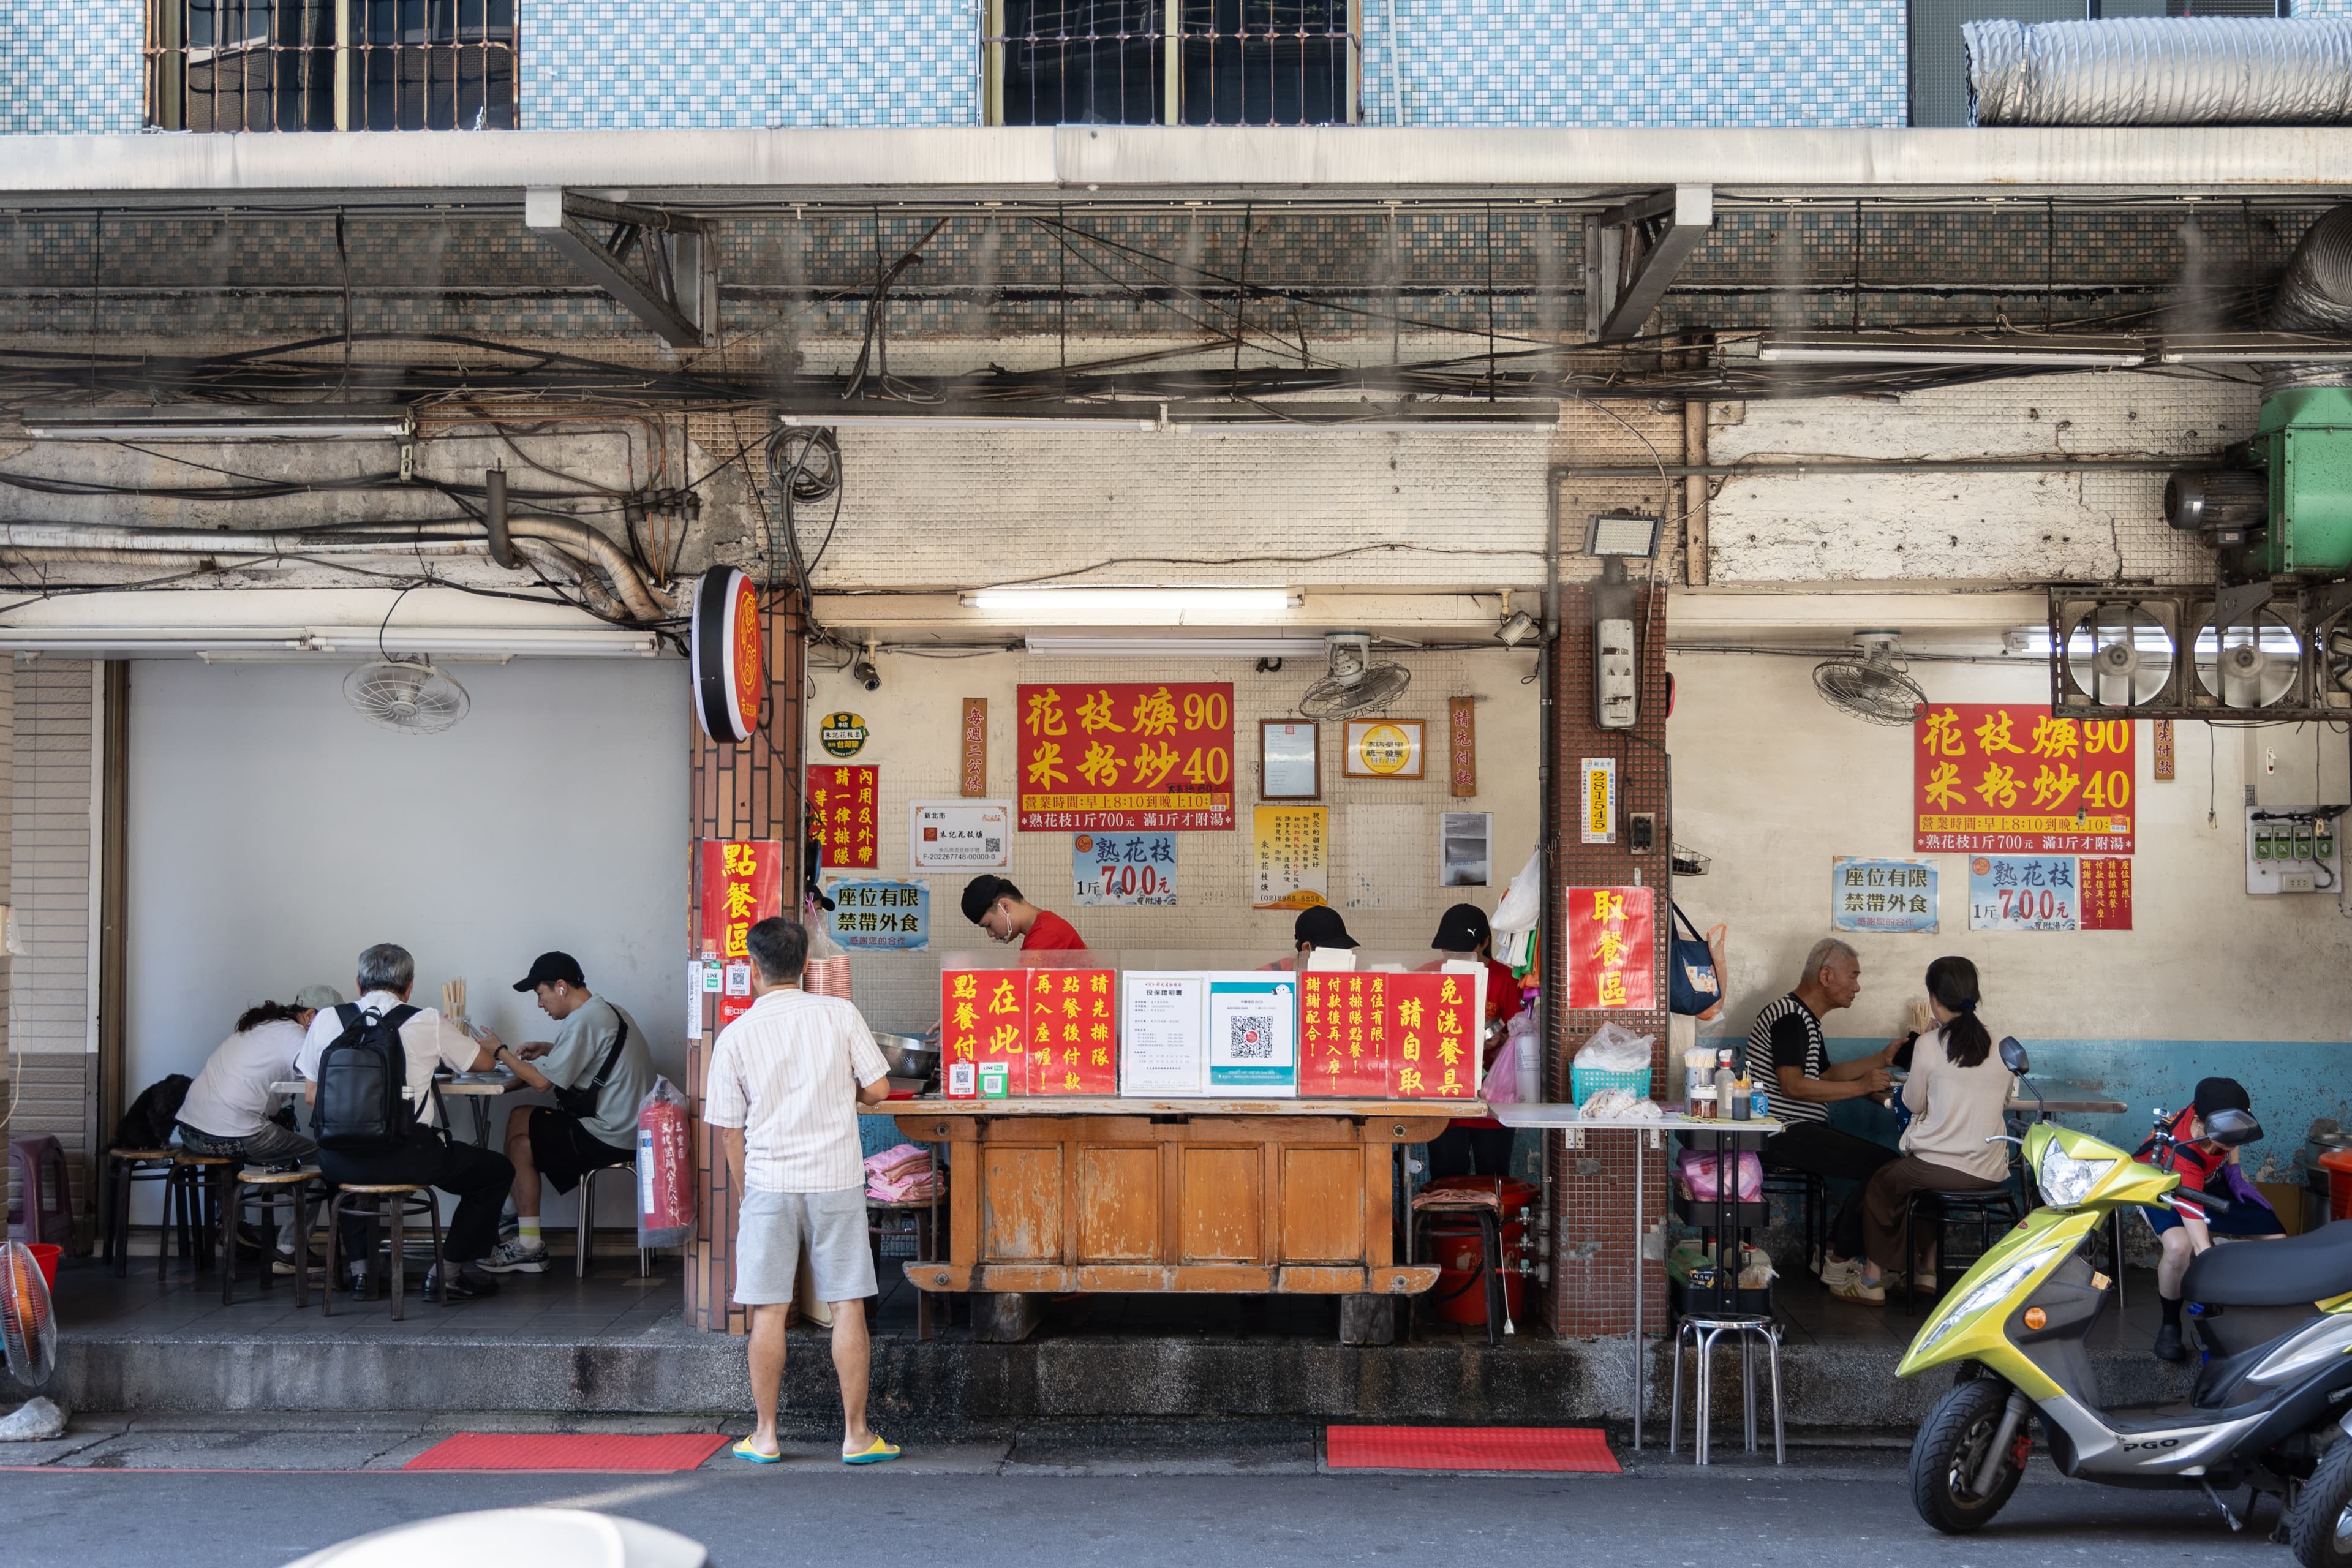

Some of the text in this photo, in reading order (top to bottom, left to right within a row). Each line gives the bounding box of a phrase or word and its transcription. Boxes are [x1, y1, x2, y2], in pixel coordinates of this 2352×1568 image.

[966, 708, 984, 791] 每週二公休
[1027, 741, 1229, 790] 米粉炒40
[1453, 709, 1473, 785] 請先付款
[1593, 772, 1605, 829] 281545
[1924, 761, 2129, 811] 米粉炒40
[834, 767, 851, 864] 請一律排隊
[858, 769, 873, 865] 內用及外帶
[1096, 837, 1175, 864] 熟花枝
[1845, 868, 1927, 888] 座位有限
[1993, 860, 2073, 888] 熟花枝
[721, 844, 757, 957] 點餐區
[838, 888, 919, 907] 座位有限
[838, 912, 919, 932] 禁帶外食
[1845, 893, 1927, 913] 禁帶外食
[1857, 917, 1915, 926] 感謝您的合作
[850, 937, 906, 945] 感謝您的合作
[1592, 890, 1629, 1006] 取餐區
[989, 978, 1023, 1055] 在此
[1062, 976, 1082, 1090] 點餐後付款
[1090, 974, 1110, 1066] 請先排隊
[1436, 976, 1465, 1096] 免洗餐具
[1398, 997, 1425, 1095] 請自取
[2124, 1439, 2179, 1452] PGO
